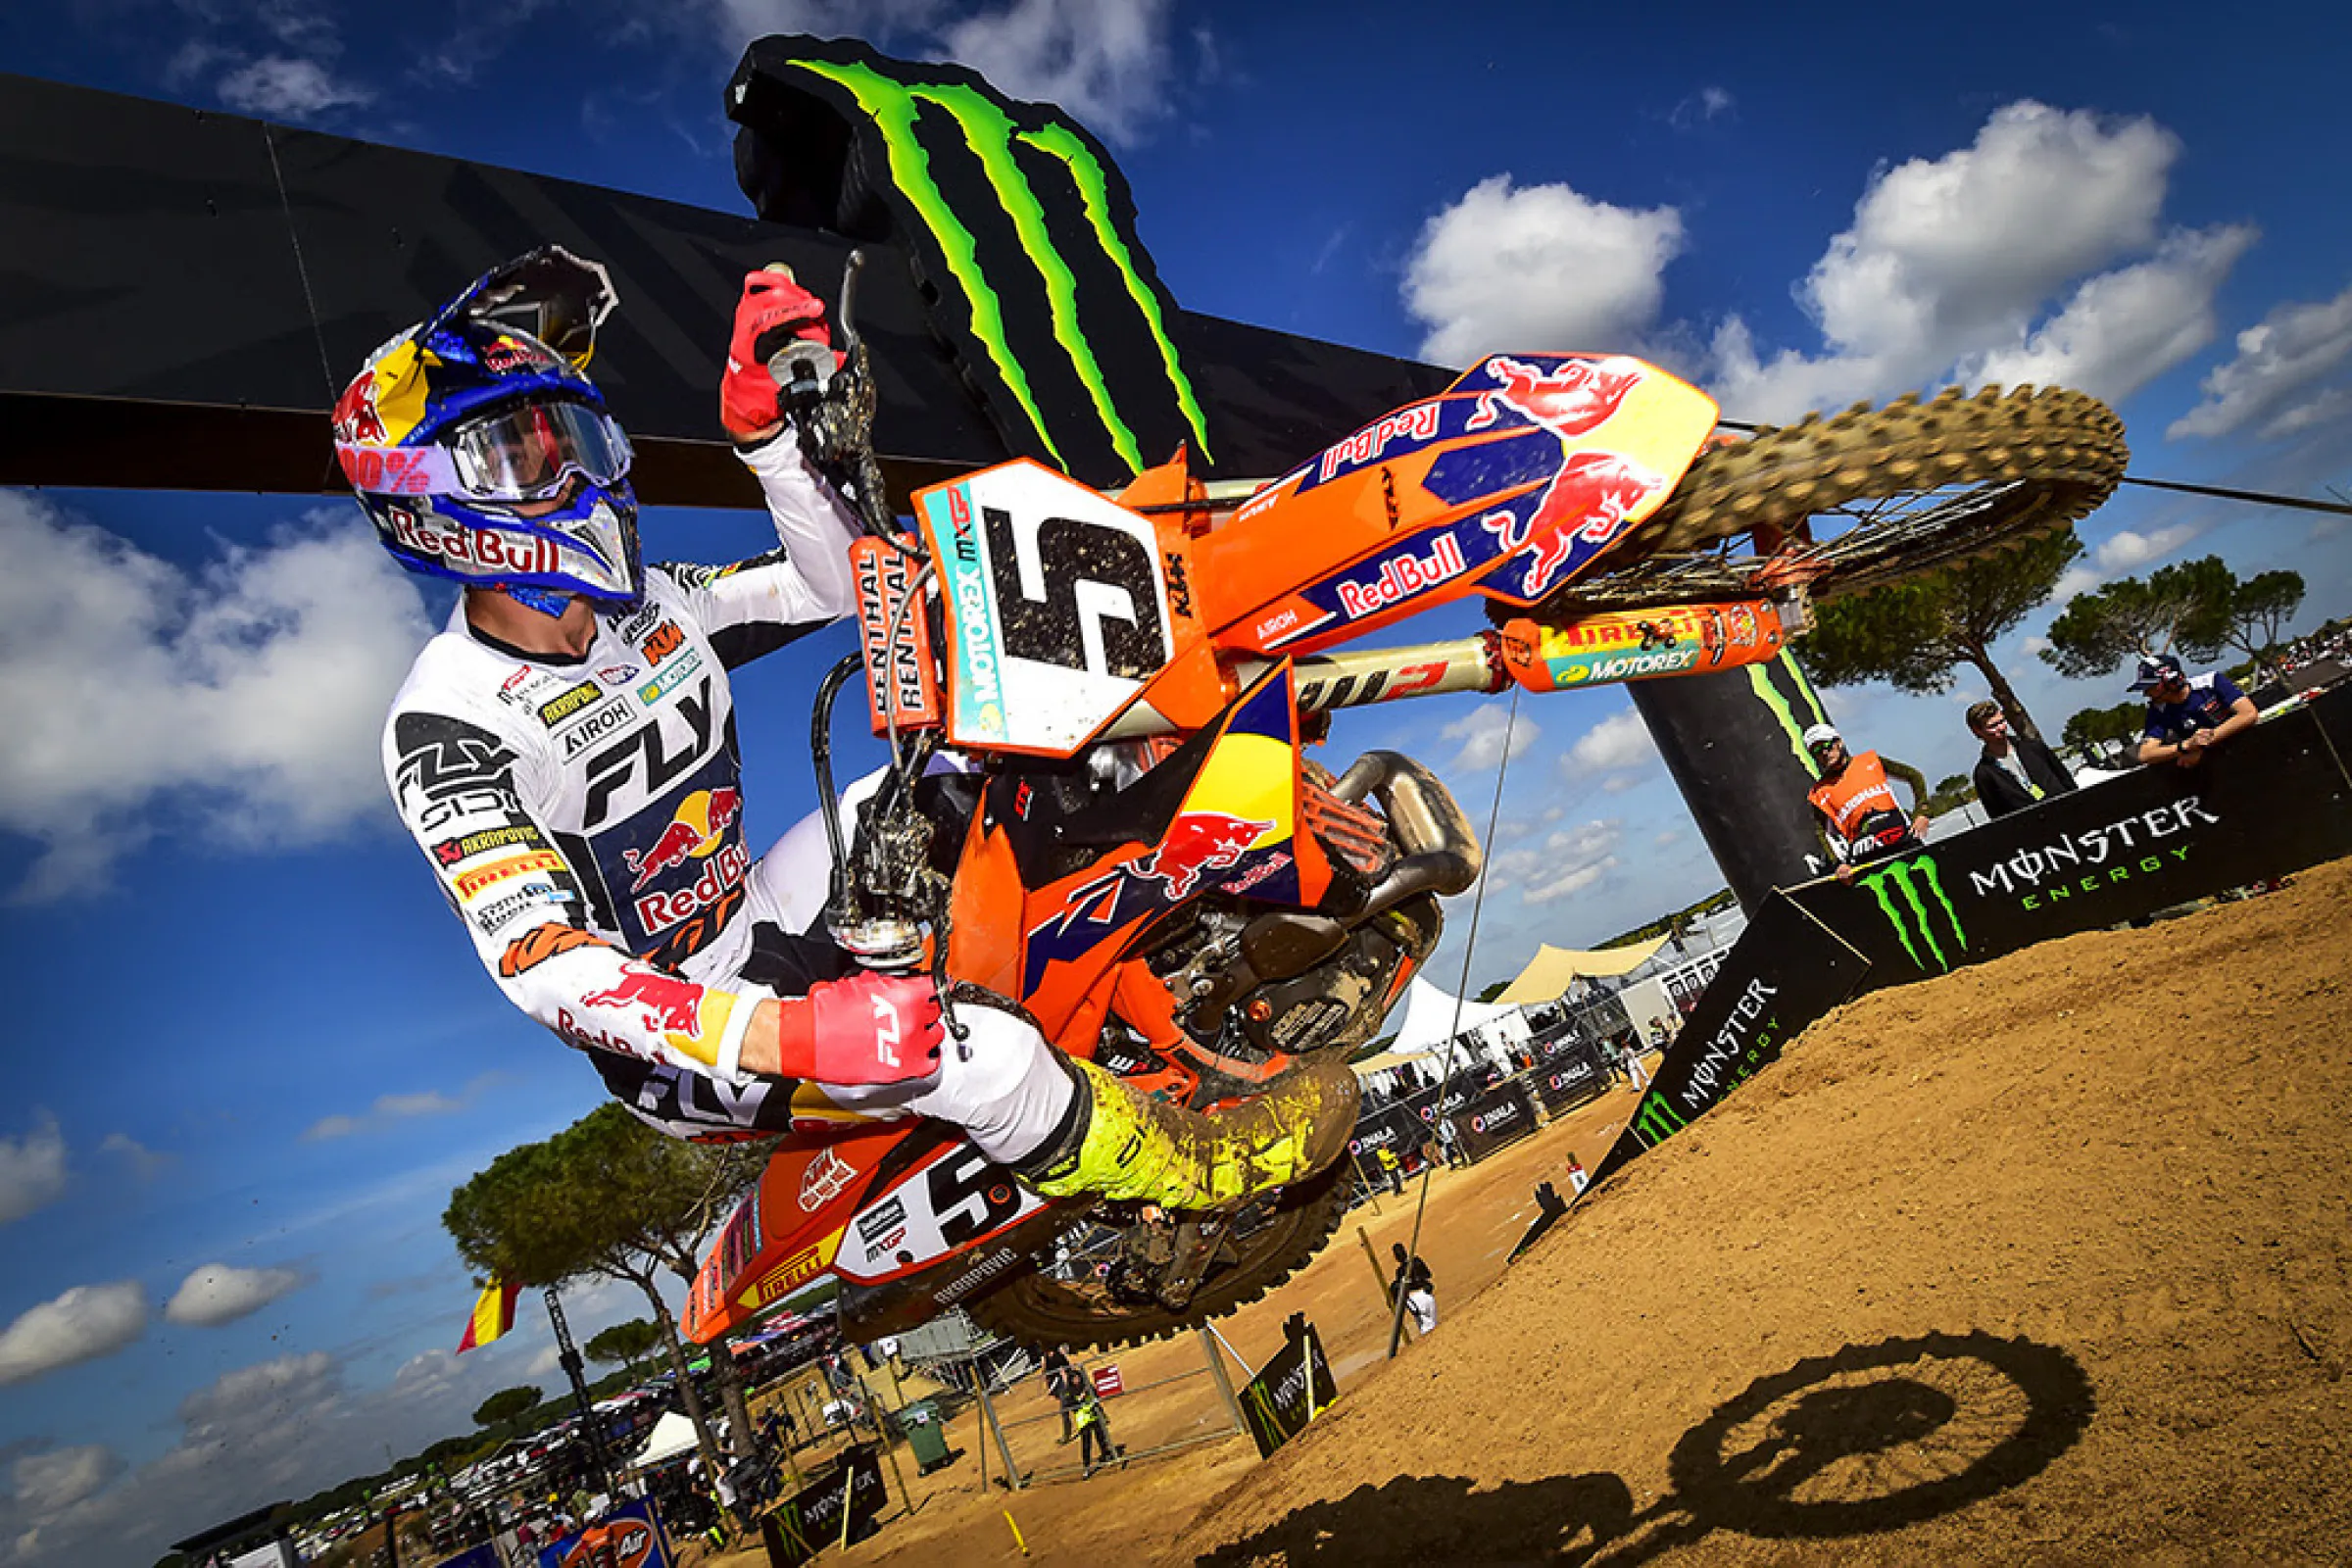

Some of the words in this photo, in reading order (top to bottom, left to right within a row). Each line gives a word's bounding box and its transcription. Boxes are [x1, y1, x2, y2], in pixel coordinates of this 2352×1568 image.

[475, 528, 561, 574] Bull
[1337, 560, 1401, 619] Red
[1396, 531, 1466, 594] Bull
[982, 505, 1168, 683] 5
[1256, 609, 1298, 640] AIROH
[642, 619, 685, 666] KTM
[955, 564, 1002, 705] MOTOREX
[1589, 650, 1694, 682] MOTOREX
[565, 702, 628, 755] AIROH
[583, 675, 712, 830] FLY
[396, 739, 519, 809] FLY
[1969, 795, 2219, 897] MONSTER
[2022, 845, 2188, 911] ENERGY
[635, 858, 722, 936] Red
[870, 993, 901, 1068] FLY
[1680, 978, 1778, 1109] MONSTER
[927, 1141, 1022, 1250] 5
[758, 1246, 824, 1304] PIRELLI
[805, 1469, 876, 1525] MONSER
[619, 1528, 649, 1556] Air
